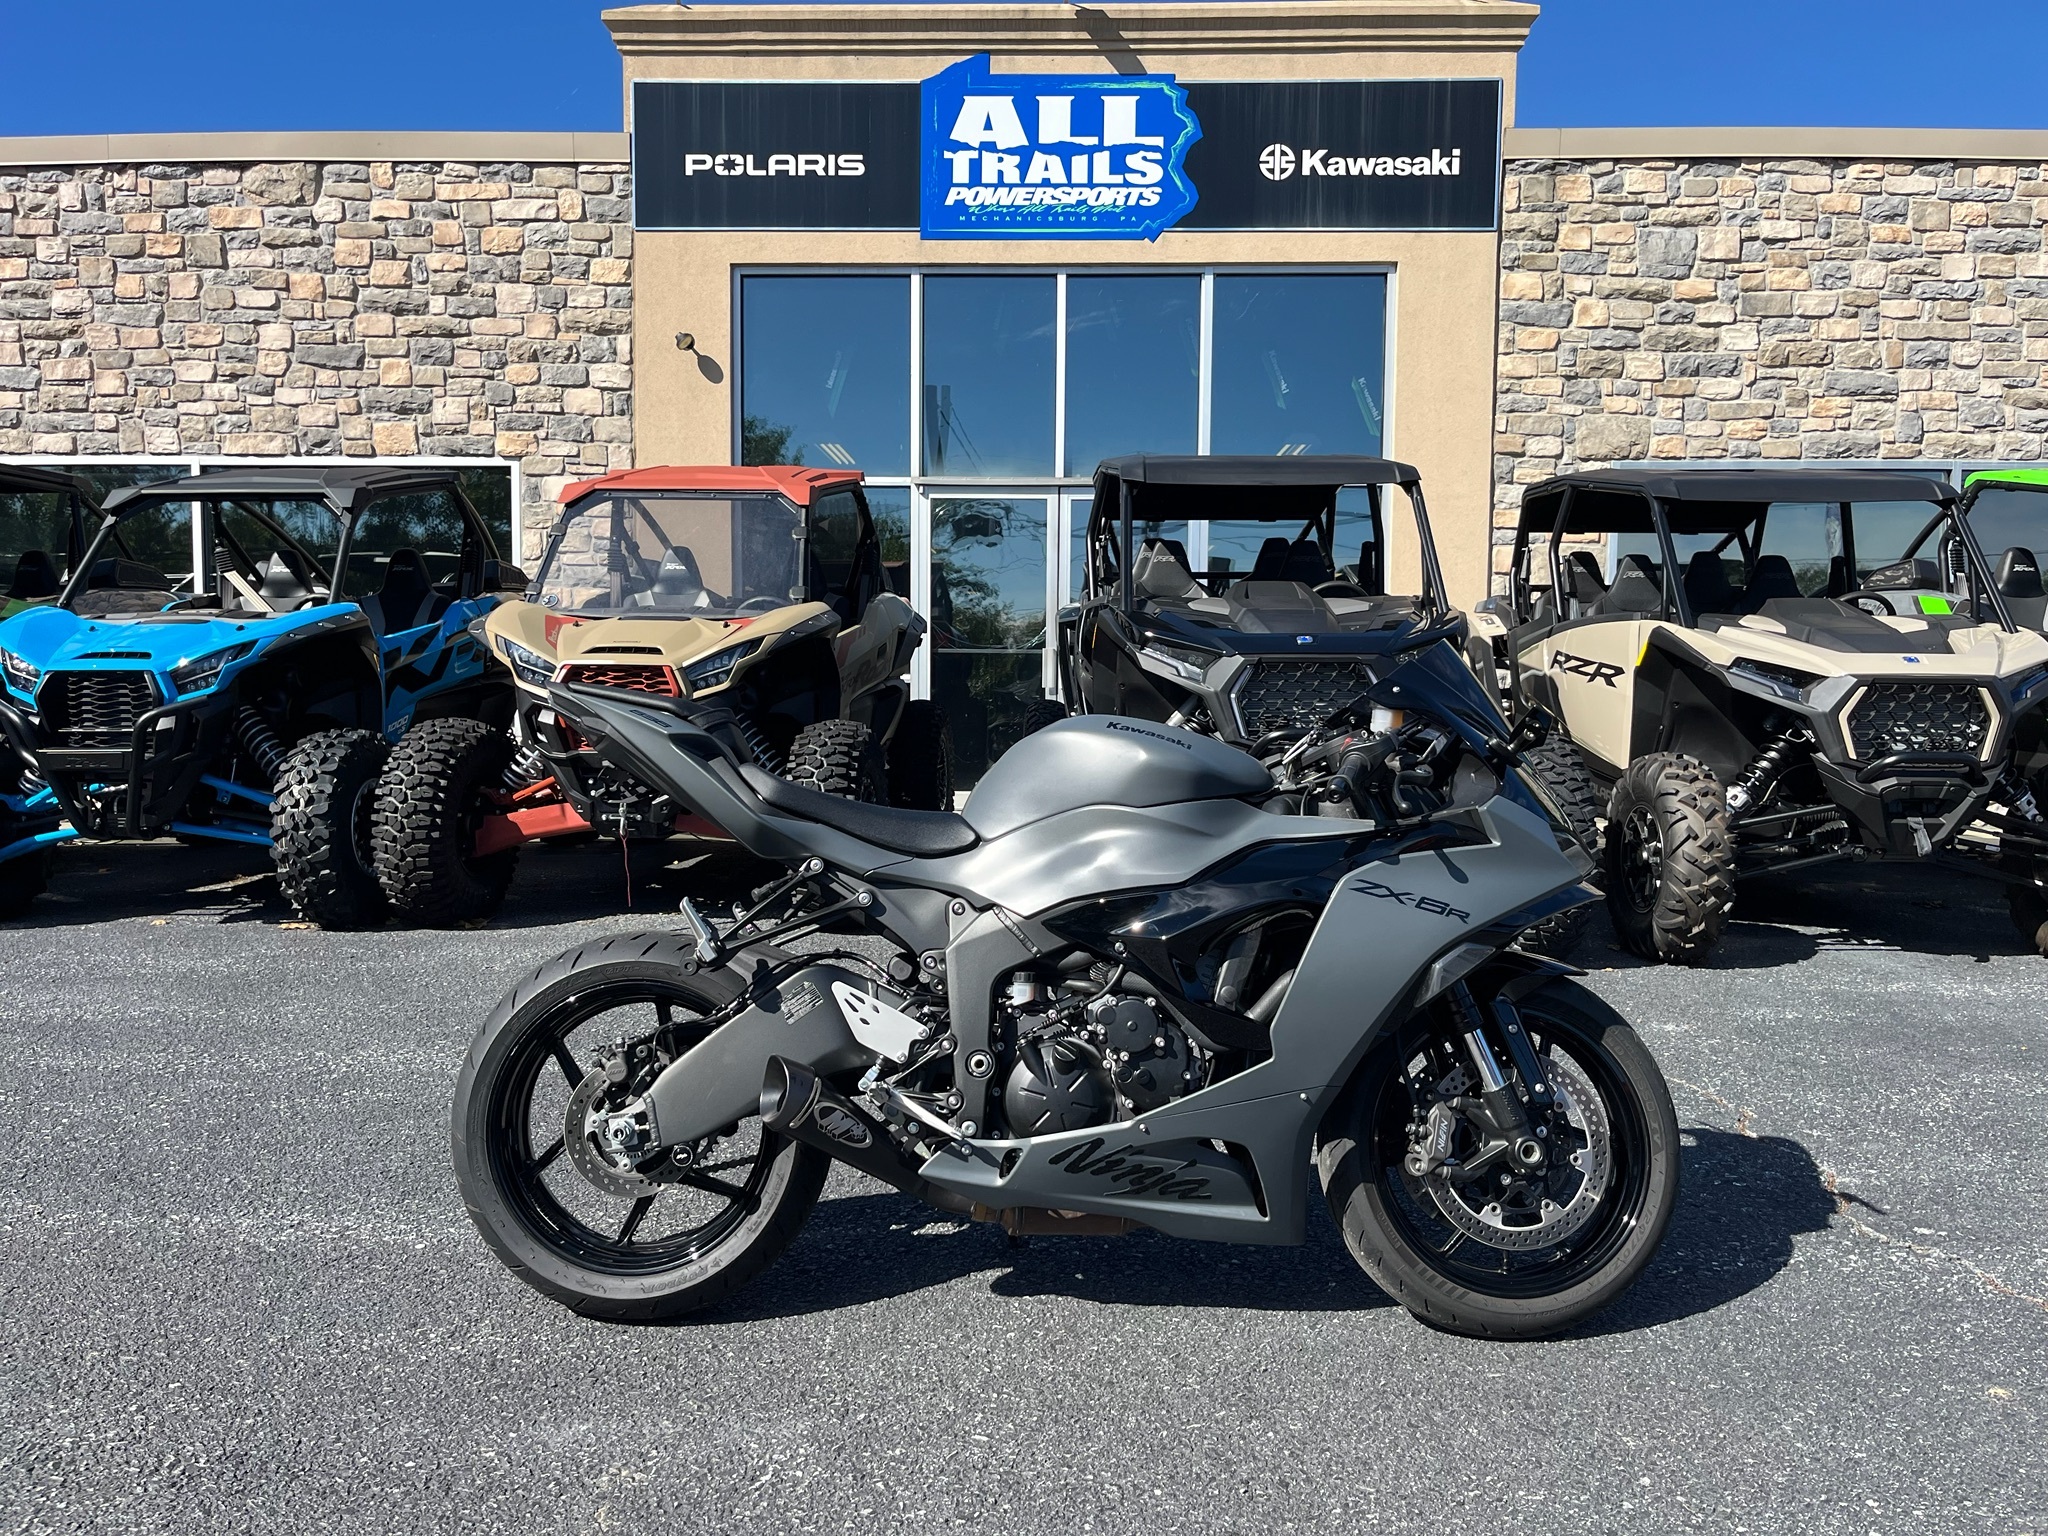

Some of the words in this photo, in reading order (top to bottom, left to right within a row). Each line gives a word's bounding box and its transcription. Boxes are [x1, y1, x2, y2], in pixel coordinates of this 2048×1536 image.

[949, 95, 1164, 150] ALL
[685, 154, 866, 176] POLARIS
[943, 150, 1164, 185] TRAILS
[1302, 148, 1461, 176] Kawasaki
[944, 187, 1162, 207] POWERSPORTS
[968, 203, 1015, 214] Where
[1017, 203, 1045, 214] All
[1050, 203, 1088, 214] Trails
[1550, 650, 1626, 689] RZR
[1106, 721, 1192, 751] Kawasaki
[1348, 879, 1471, 925] ZX-6R
[1048, 1137, 1213, 1200] Ninja
